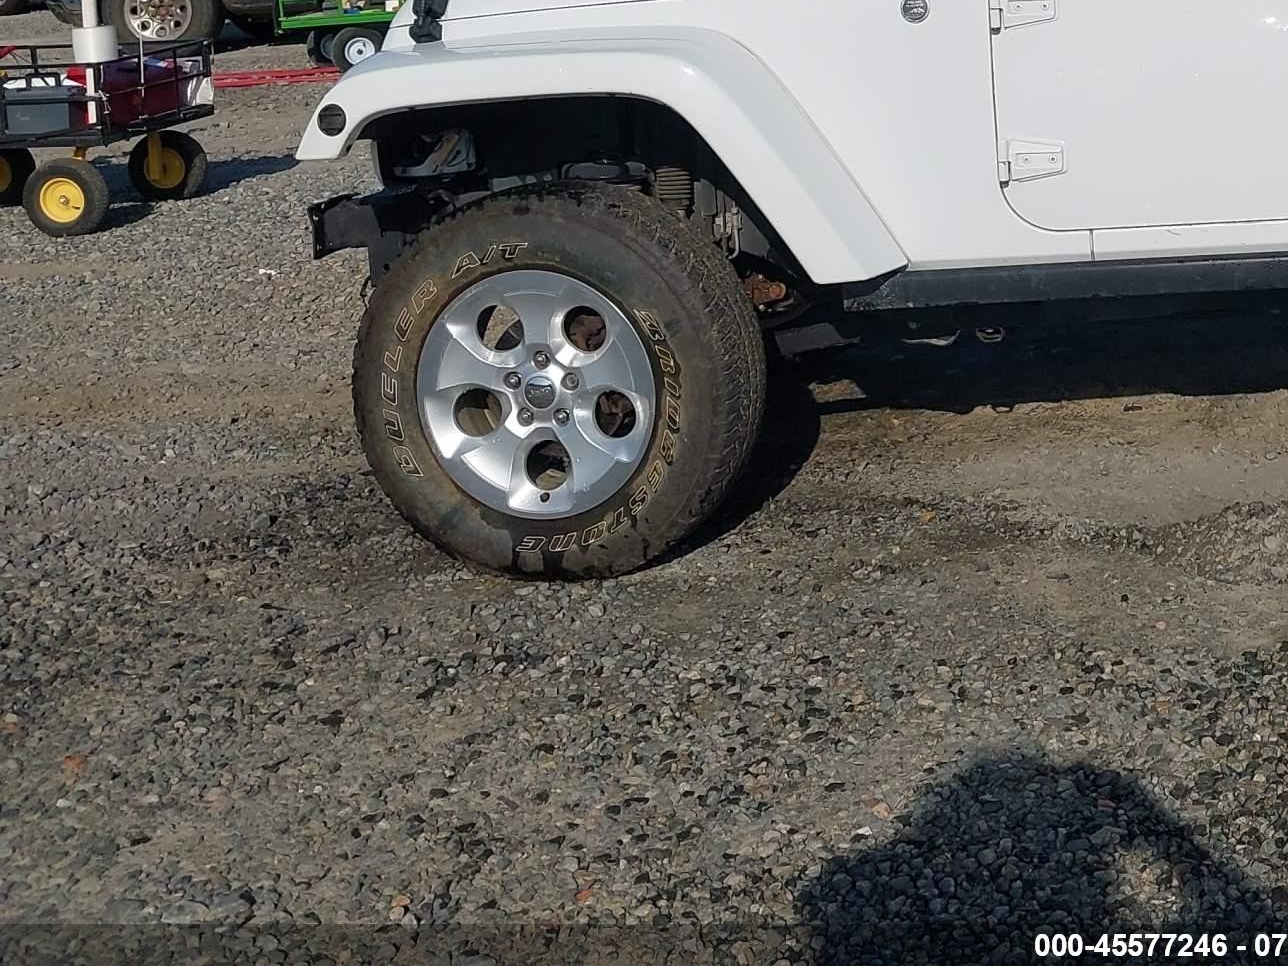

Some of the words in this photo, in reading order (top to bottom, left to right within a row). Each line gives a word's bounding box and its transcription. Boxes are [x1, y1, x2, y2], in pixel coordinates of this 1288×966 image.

[382, 279, 437, 477] DUELER
[452, 242, 528, 278] A/T
[516, 309, 682, 552] BRIDGESTONE
